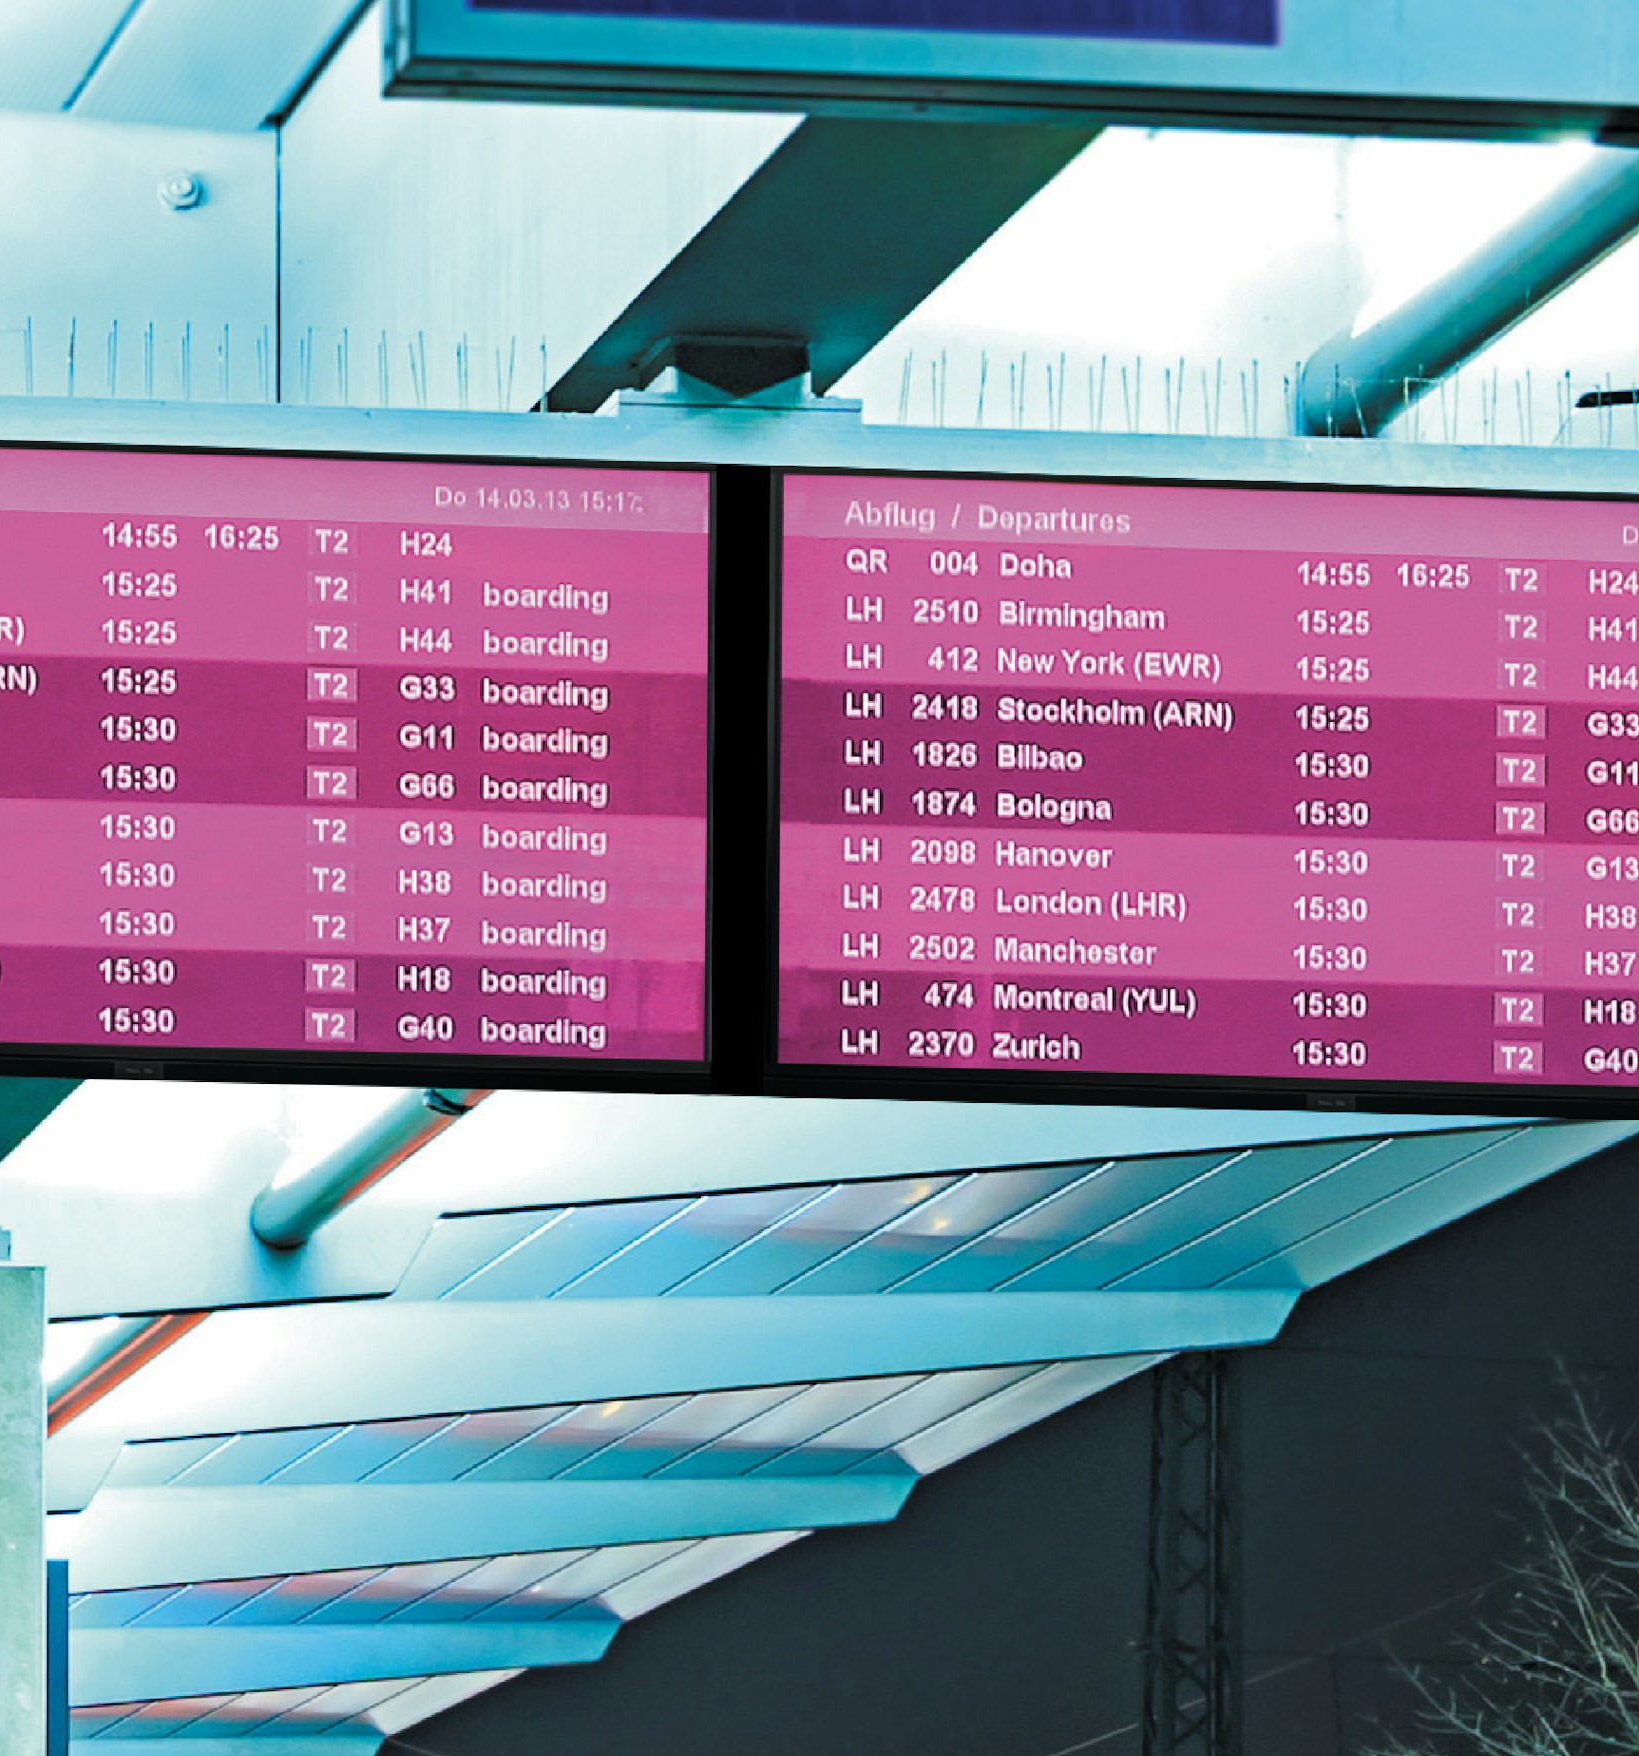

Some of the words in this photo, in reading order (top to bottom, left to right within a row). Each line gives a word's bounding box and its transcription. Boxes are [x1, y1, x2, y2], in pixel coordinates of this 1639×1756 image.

[435, 486, 467, 506] Do
[478, 487, 570, 510] 14.03.13
[844, 500, 936, 532] Abflug
[978, 504, 1130, 535] Departures
[102, 521, 178, 549] 14:55
[204, 524, 280, 551] 16:25
[315, 528, 349, 554] T2
[400, 530, 453, 558] H24
[102, 570, 178, 598] 15:25
[314, 575, 349, 602] T2
[400, 578, 451, 605] H41
[483, 581, 608, 616] boarding
[846, 548, 888, 574] QR
[930, 550, 979, 577] 004
[1000, 552, 1072, 579] Doha
[1297, 560, 1371, 587] 14:55
[1397, 562, 1471, 589] 16:25
[1504, 567, 1538, 593] T2
[1589, 568, 1639, 596] H24
[102, 618, 178, 646] 15:25
[313, 625, 348, 651] T2
[400, 626, 453, 654] H44
[483, 629, 608, 664] boarding
[846, 595, 883, 623] LH
[913, 598, 979, 625] 2510
[999, 600, 1165, 633] Birmingham
[1297, 609, 1370, 635] 15:25
[1504, 613, 1538, 640] T2
[1588, 616, 1638, 643] H41
[846, 642, 882, 670] LH
[927, 646, 978, 672] 412
[997, 647, 1055, 674] New
[1060, 649, 1125, 676] York
[1133, 651, 1221, 685] (EWR)
[1296, 656, 1370, 683] 15:25
[1503, 662, 1538, 688] T2
[1588, 663, 1639, 690] H44
[101, 667, 177, 695] 15:25
[313, 672, 348, 698] T2
[399, 675, 455, 702] G33
[483, 677, 609, 712] boarding
[845, 691, 883, 719] LH
[911, 693, 978, 721] 2418
[997, 697, 1146, 727] Stockholm
[1153, 700, 1233, 733] (ARN)
[1295, 704, 1370, 732] 15:25
[1502, 707, 1537, 734] T2
[100, 714, 176, 742] 15:30
[313, 721, 348, 747] T2
[399, 723, 453, 751] G11
[482, 725, 608, 760] boarding
[100, 763, 176, 791] 15:30
[312, 766, 348, 793] T2
[399, 772, 455, 799] G66
[482, 774, 608, 808] boarding
[844, 787, 881, 815] LH
[911, 789, 976, 817] 1874
[997, 792, 1113, 825] Bologna
[1294, 800, 1369, 827] 15:30
[1502, 802, 1535, 828] T2
[100, 813, 176, 841] 15:30
[311, 818, 348, 844] T2
[399, 820, 454, 846] G13
[482, 823, 607, 856] boarding
[100, 861, 176, 888] 15:30
[311, 866, 346, 893] T2
[399, 869, 451, 895] H38
[482, 870, 607, 904] boarding
[843, 883, 879, 911] LH
[909, 886, 976, 913] 2478
[996, 887, 1102, 916] London
[1110, 891, 1186, 923] (LHR)
[1293, 895, 1368, 922] 15:30
[1501, 901, 1535, 927] T2
[1585, 902, 1637, 930] H38
[99, 911, 174, 937] 15:30
[311, 914, 346, 940] T2
[399, 916, 451, 944] H37
[481, 920, 606, 953] boarding
[98, 958, 174, 985] 15:30
[311, 963, 346, 989] T2
[397, 965, 451, 993] H18
[481, 967, 606, 1002] boarding
[841, 979, 879, 1007] LH
[924, 981, 974, 1009] 474
[993, 984, 1114, 1012] Montreal
[1122, 987, 1196, 1020] (YUL)
[1292, 991, 1367, 1018] 15:30
[1501, 996, 1534, 1022] T2
[1584, 999, 1637, 1025] H18
[98, 1007, 174, 1034] 15:30
[311, 1012, 346, 1038] T2
[397, 1014, 453, 1041] G40
[481, 1016, 606, 1051] boarding
